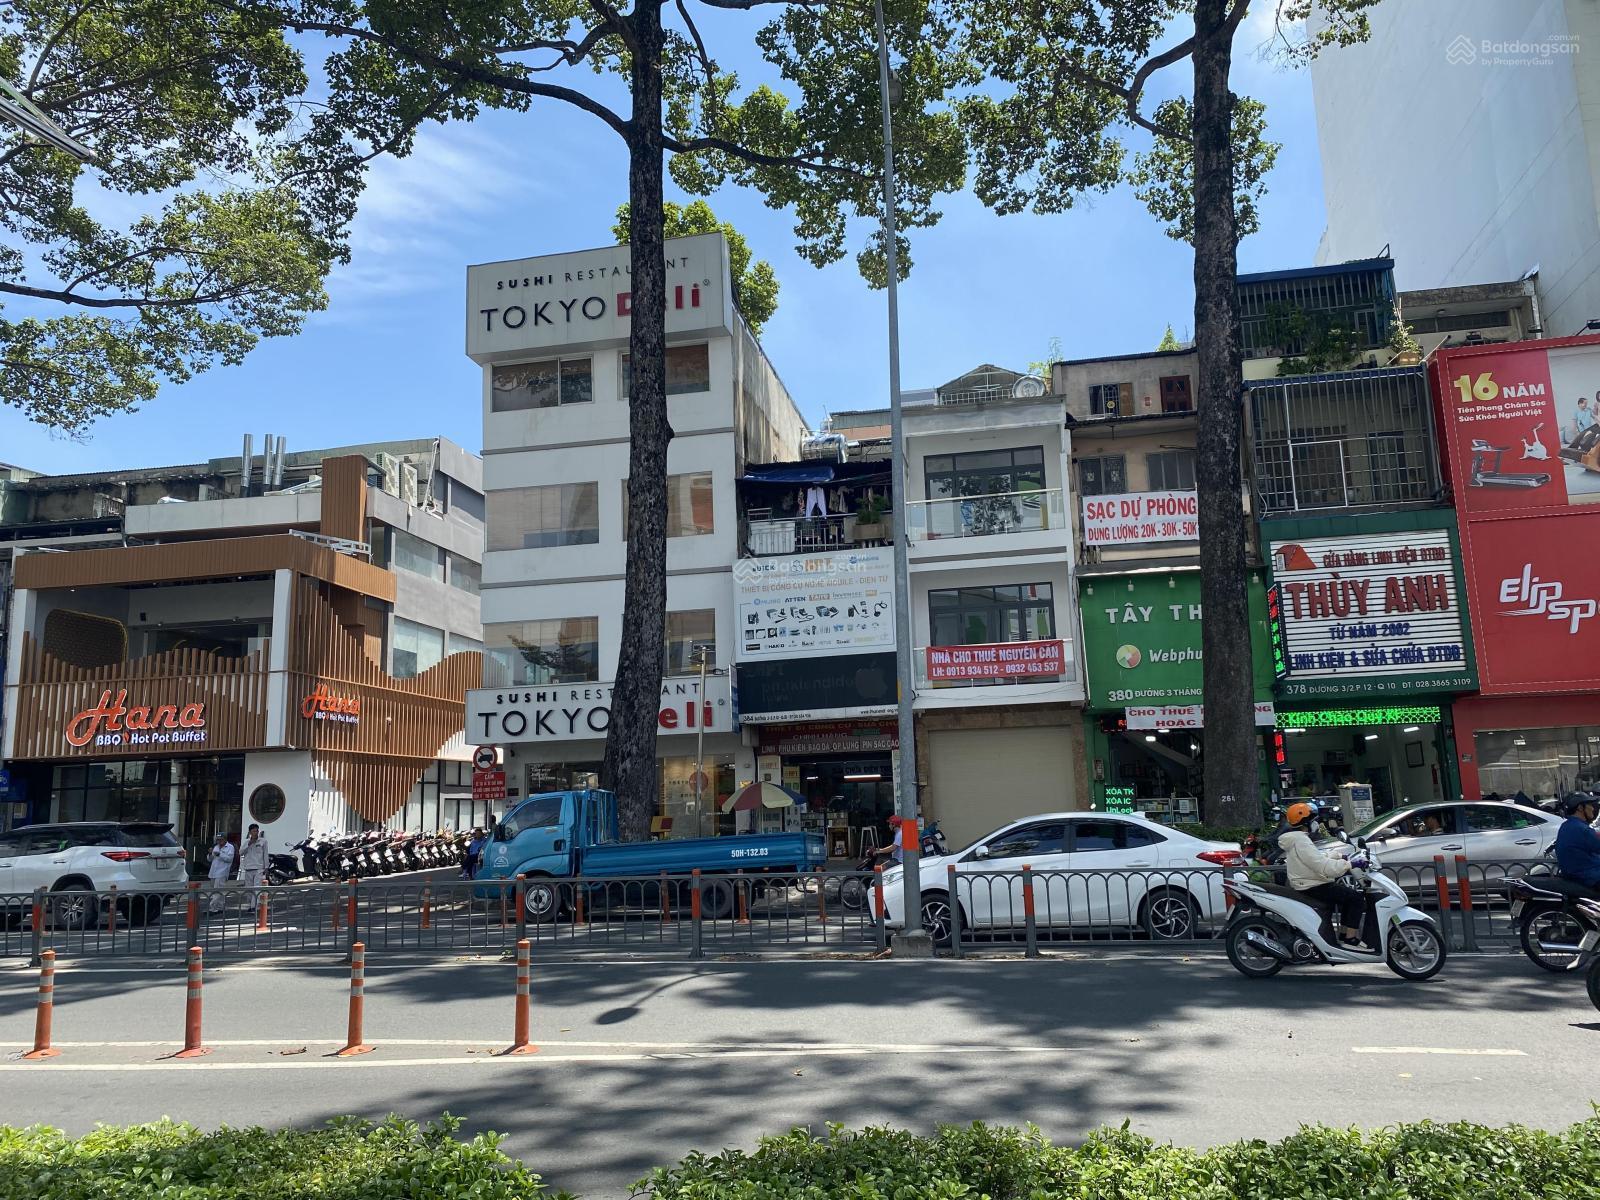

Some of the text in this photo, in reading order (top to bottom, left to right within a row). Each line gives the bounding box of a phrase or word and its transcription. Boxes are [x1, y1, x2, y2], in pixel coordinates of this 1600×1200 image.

[496, 257, 689, 290] SUSHI RESTAUNT
[480, 282, 700, 332] TOKYO Dli
[1453, 372, 1546, 403] 16 NĂM
[1476, 405, 1503, 413] Phong
[1498, 409, 1524, 419] Người
[1524, 408, 1542, 417] Việt
[1086, 493, 1198, 523] SẠC DỰ PHÒNG
[1088, 527, 1110, 541] DUNG
[1112, 522, 1139, 542] LƯỢNG
[1141, 523, 1157, 537] 20K
[1162, 522, 1177, 536] 30K
[1182, 521, 1198, 535] 50K
[1285, 572, 1449, 619] THÙY ANH
[1105, 602, 1202, 624] TÂY TH
[1547, 599, 1600, 634] sp
[1381, 623, 1410, 636] 2002
[931, 650, 951, 664] NHÀ
[953, 651, 971, 664] CHO
[973, 648, 997, 662] THUÊ
[998, 646, 1037, 662] NGUYÊN
[1149, 646, 1202, 665] Webphu
[932, 667, 945, 677] LH:
[946, 667, 965, 676] 0913
[967, 666, 981, 675] 934
[983, 665, 999, 675] 512
[1005, 664, 1026, 674] 0932
[1028, 663, 1043, 673] 463
[1044, 662, 1059, 671] 537
[496, 683, 701, 705] SUSHI RESTANT
[1108, 689, 1134, 702] 380
[1286, 684, 1307, 694] 378
[1453, 678, 1471, 686] 3109
[302, 682, 360, 719] Hana
[66, 688, 206, 747] Hana
[477, 700, 713, 738] TOKYO eli
[1129, 709, 1156, 717] CHO
[1160, 706, 1195, 716] THUÊ
[96, 731, 206, 745] BBQ Hot Pot Buffet
[731, 848, 769, 858] 50H-132.03
